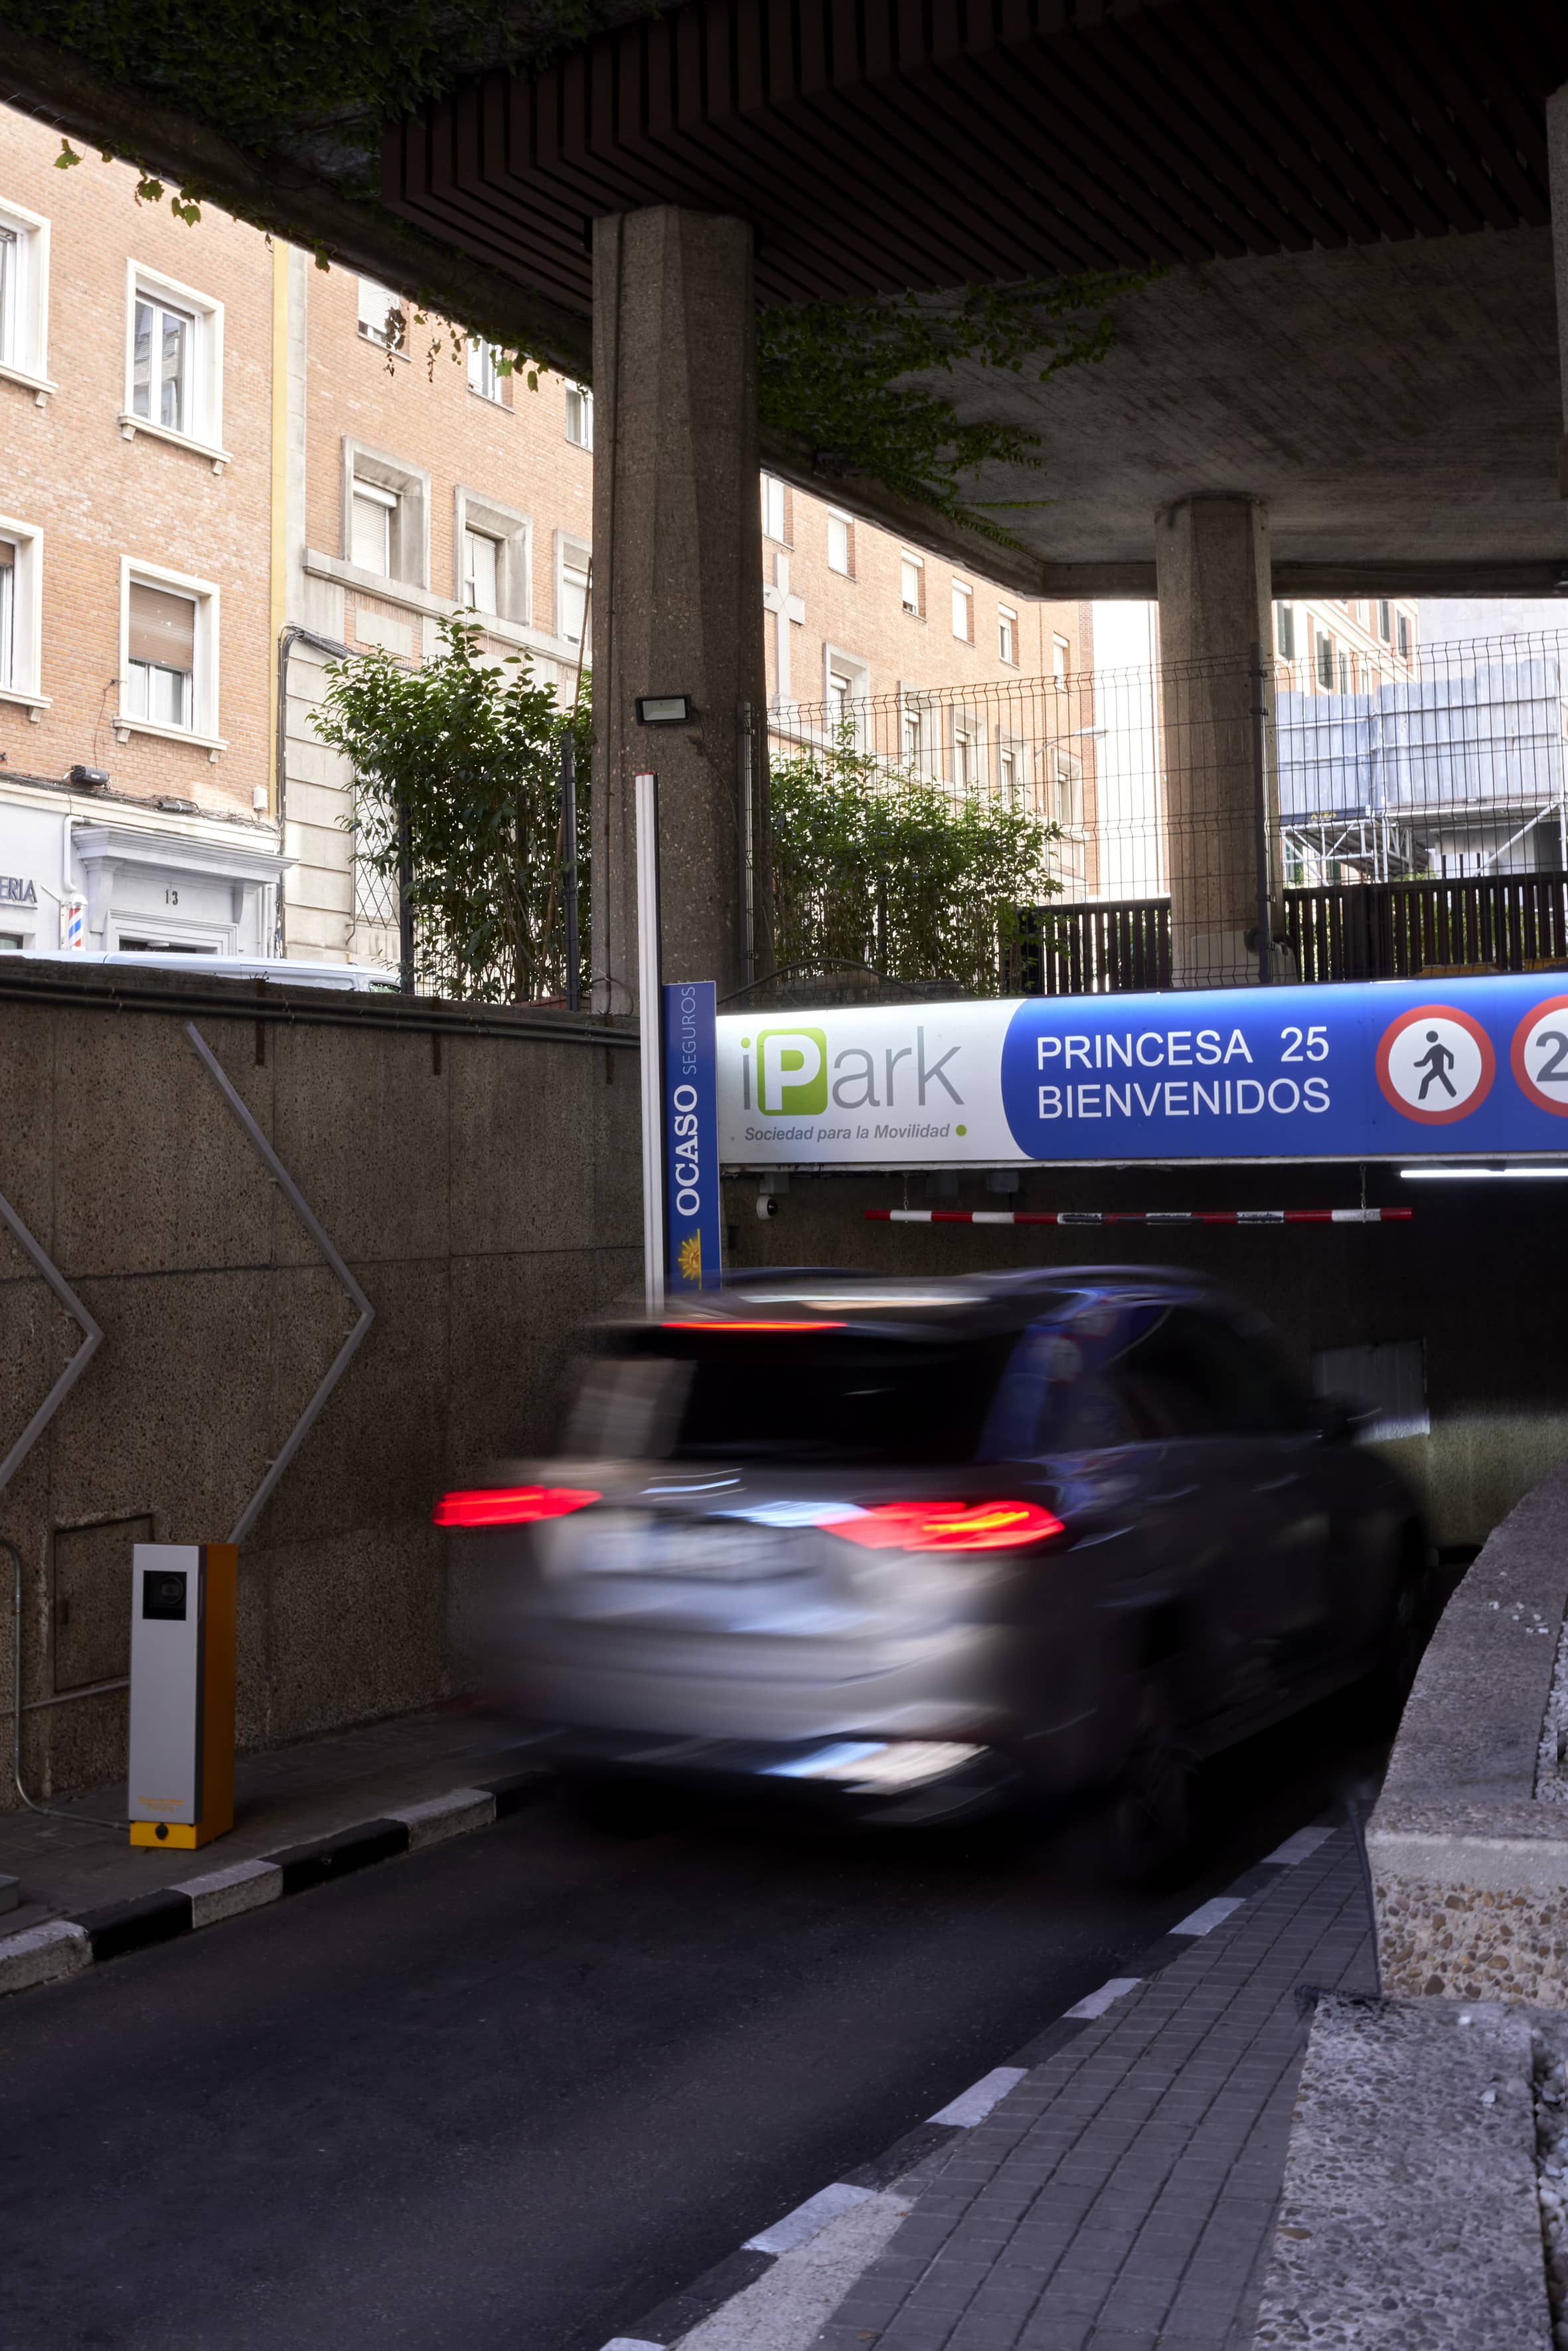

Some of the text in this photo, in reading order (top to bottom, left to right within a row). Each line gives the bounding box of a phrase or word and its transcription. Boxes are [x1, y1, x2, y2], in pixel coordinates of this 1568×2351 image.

[0, 876, 38, 903] ERIA
[165, 889, 179, 906] 13
[741, 1026, 965, 1111] iPark
[1037, 1026, 1330, 1070] PRINCESA 25
[673, 986, 700, 1217] OCASO SEGUROS
[1038, 1077, 1331, 1119] BIENVENIDOS
[744, 1123, 951, 1143] Sociedad para la Movilidad
